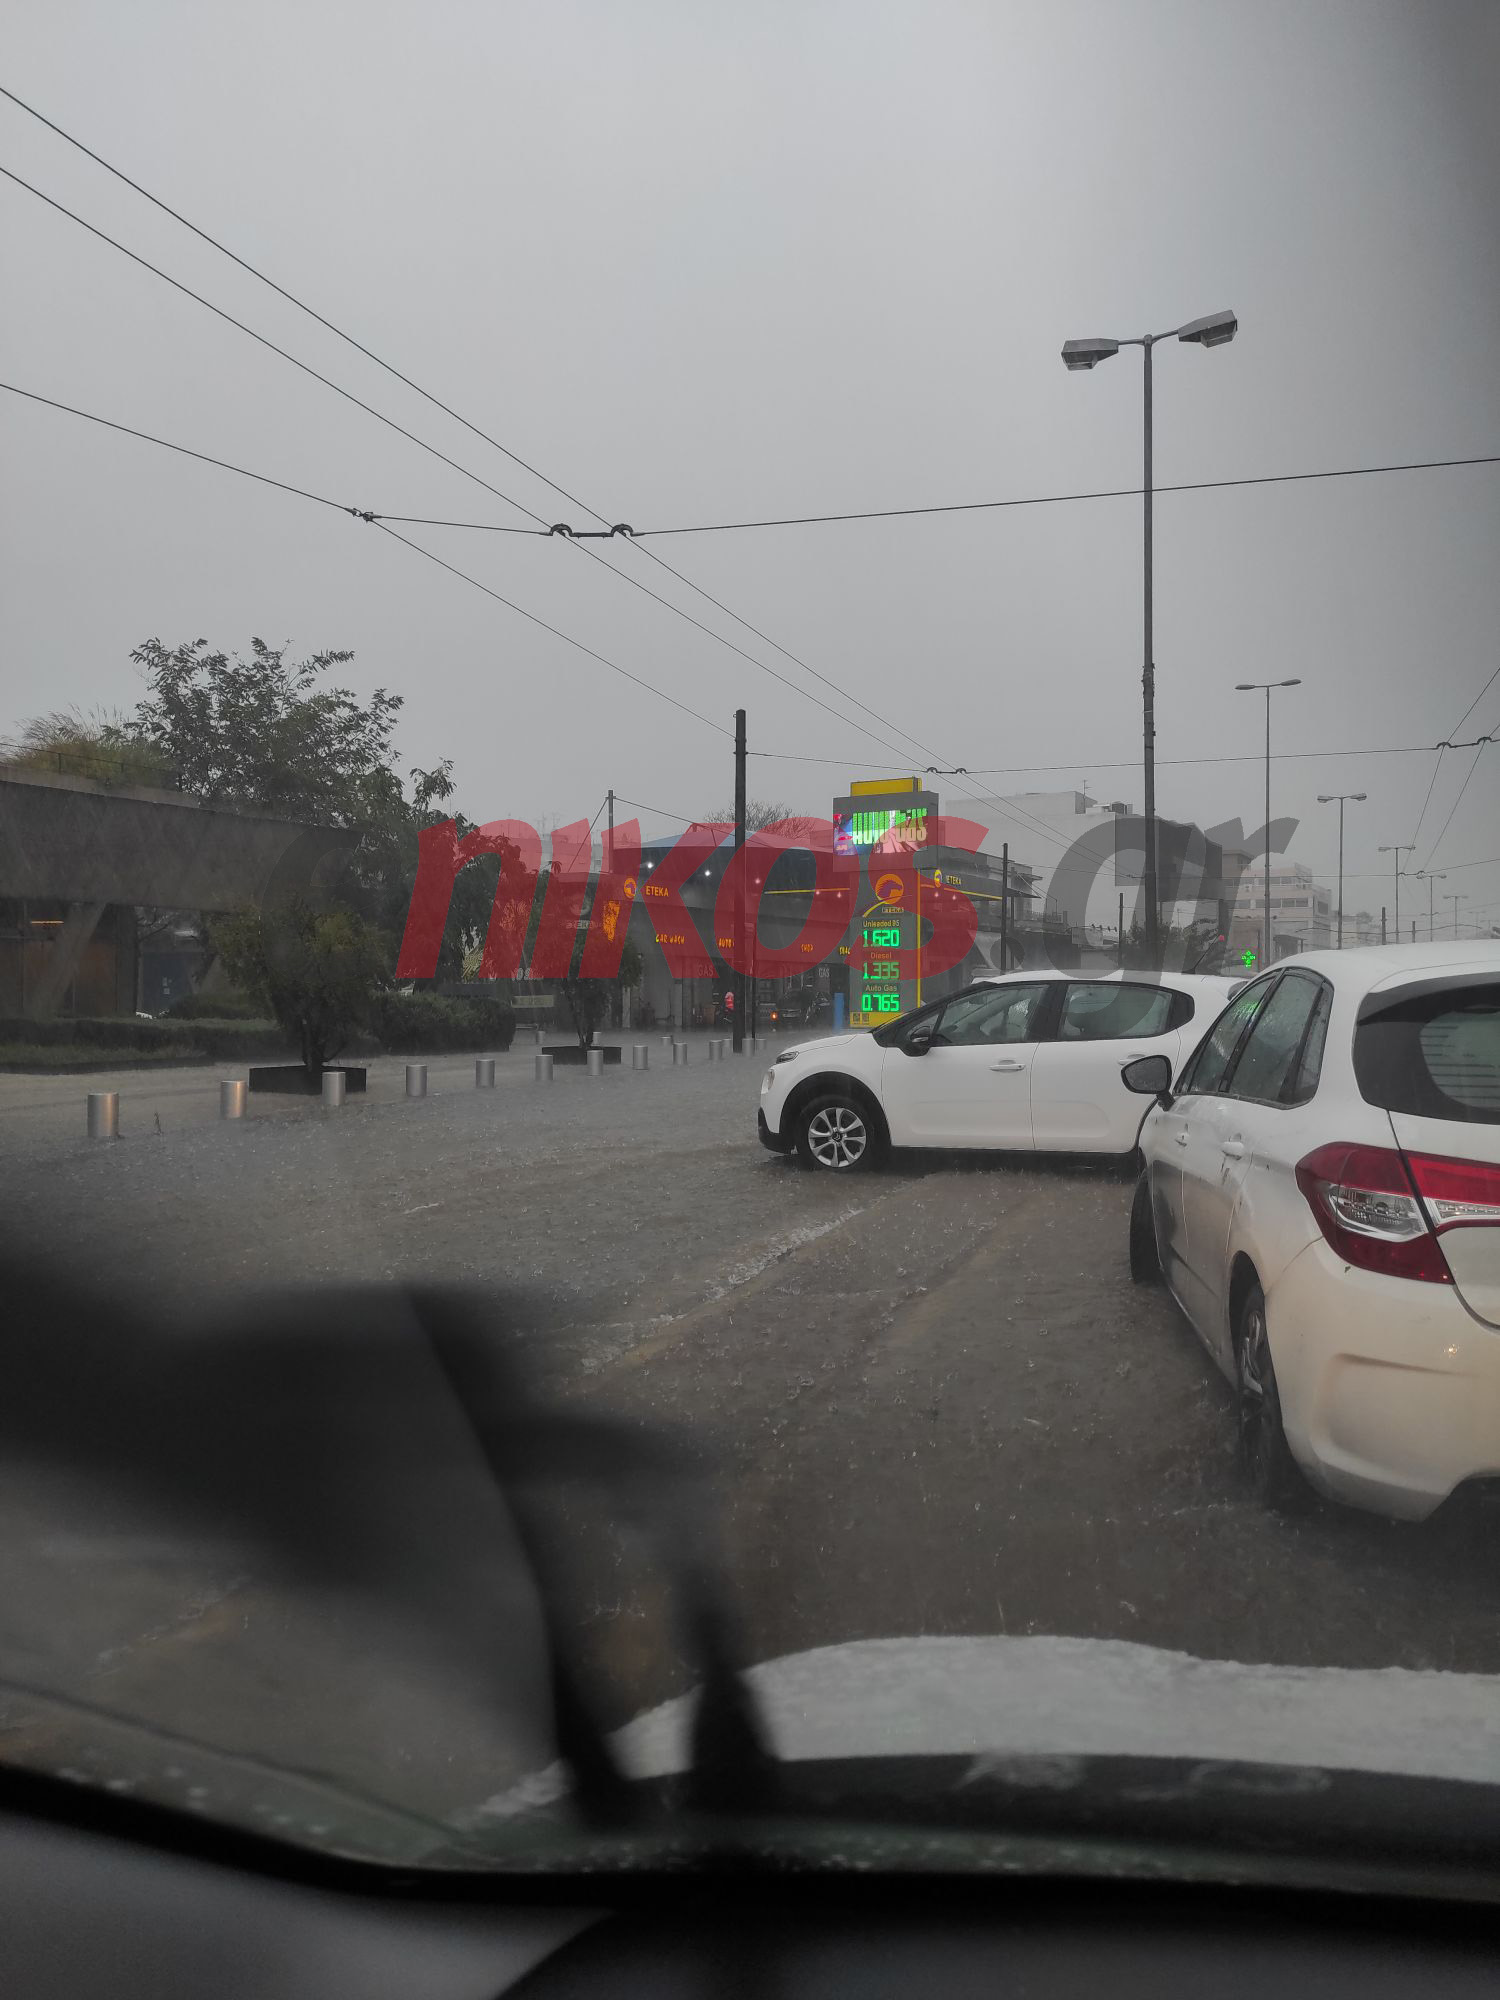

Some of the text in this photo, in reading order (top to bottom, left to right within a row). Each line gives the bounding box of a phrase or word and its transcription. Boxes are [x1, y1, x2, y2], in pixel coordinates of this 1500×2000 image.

[645, 885, 669, 897] ETEKA
[863, 920, 892, 928] Unleaded
[863, 929, 900, 947] 1.620
[870, 951, 892, 959] Diesel
[698, 965, 714, 976] GAS
[818, 968, 830, 978] GAS
[863, 962, 900, 980] 1.335
[865, 984, 898, 992] Auto Gas
[862, 994, 900, 1012] 0.765
